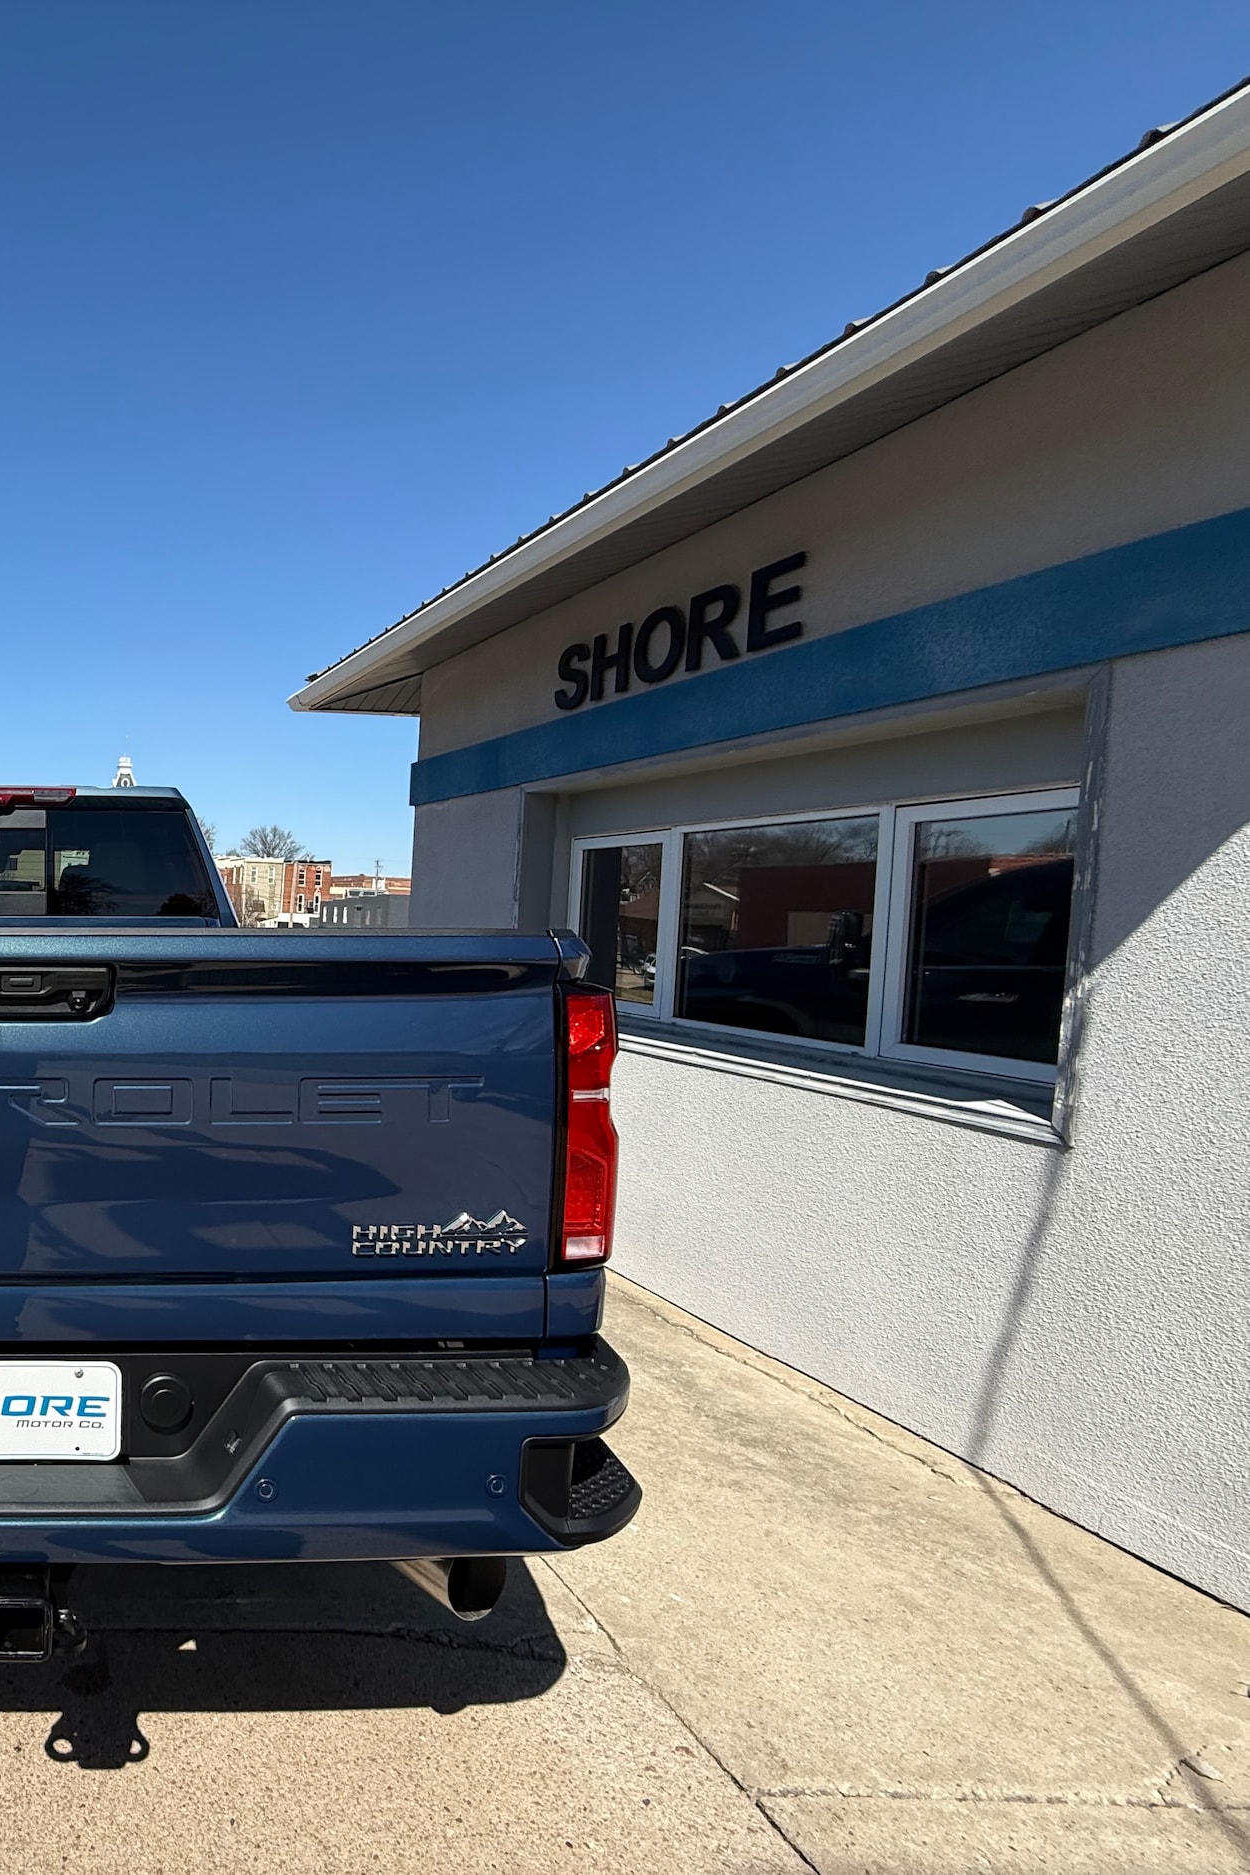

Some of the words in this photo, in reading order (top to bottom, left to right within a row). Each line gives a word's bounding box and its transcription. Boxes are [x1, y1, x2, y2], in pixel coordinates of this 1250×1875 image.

[554, 551, 807, 710] SHORE
[352, 1224, 442, 1240] HIGH
[352, 1238, 527, 1256] COUNTRY
